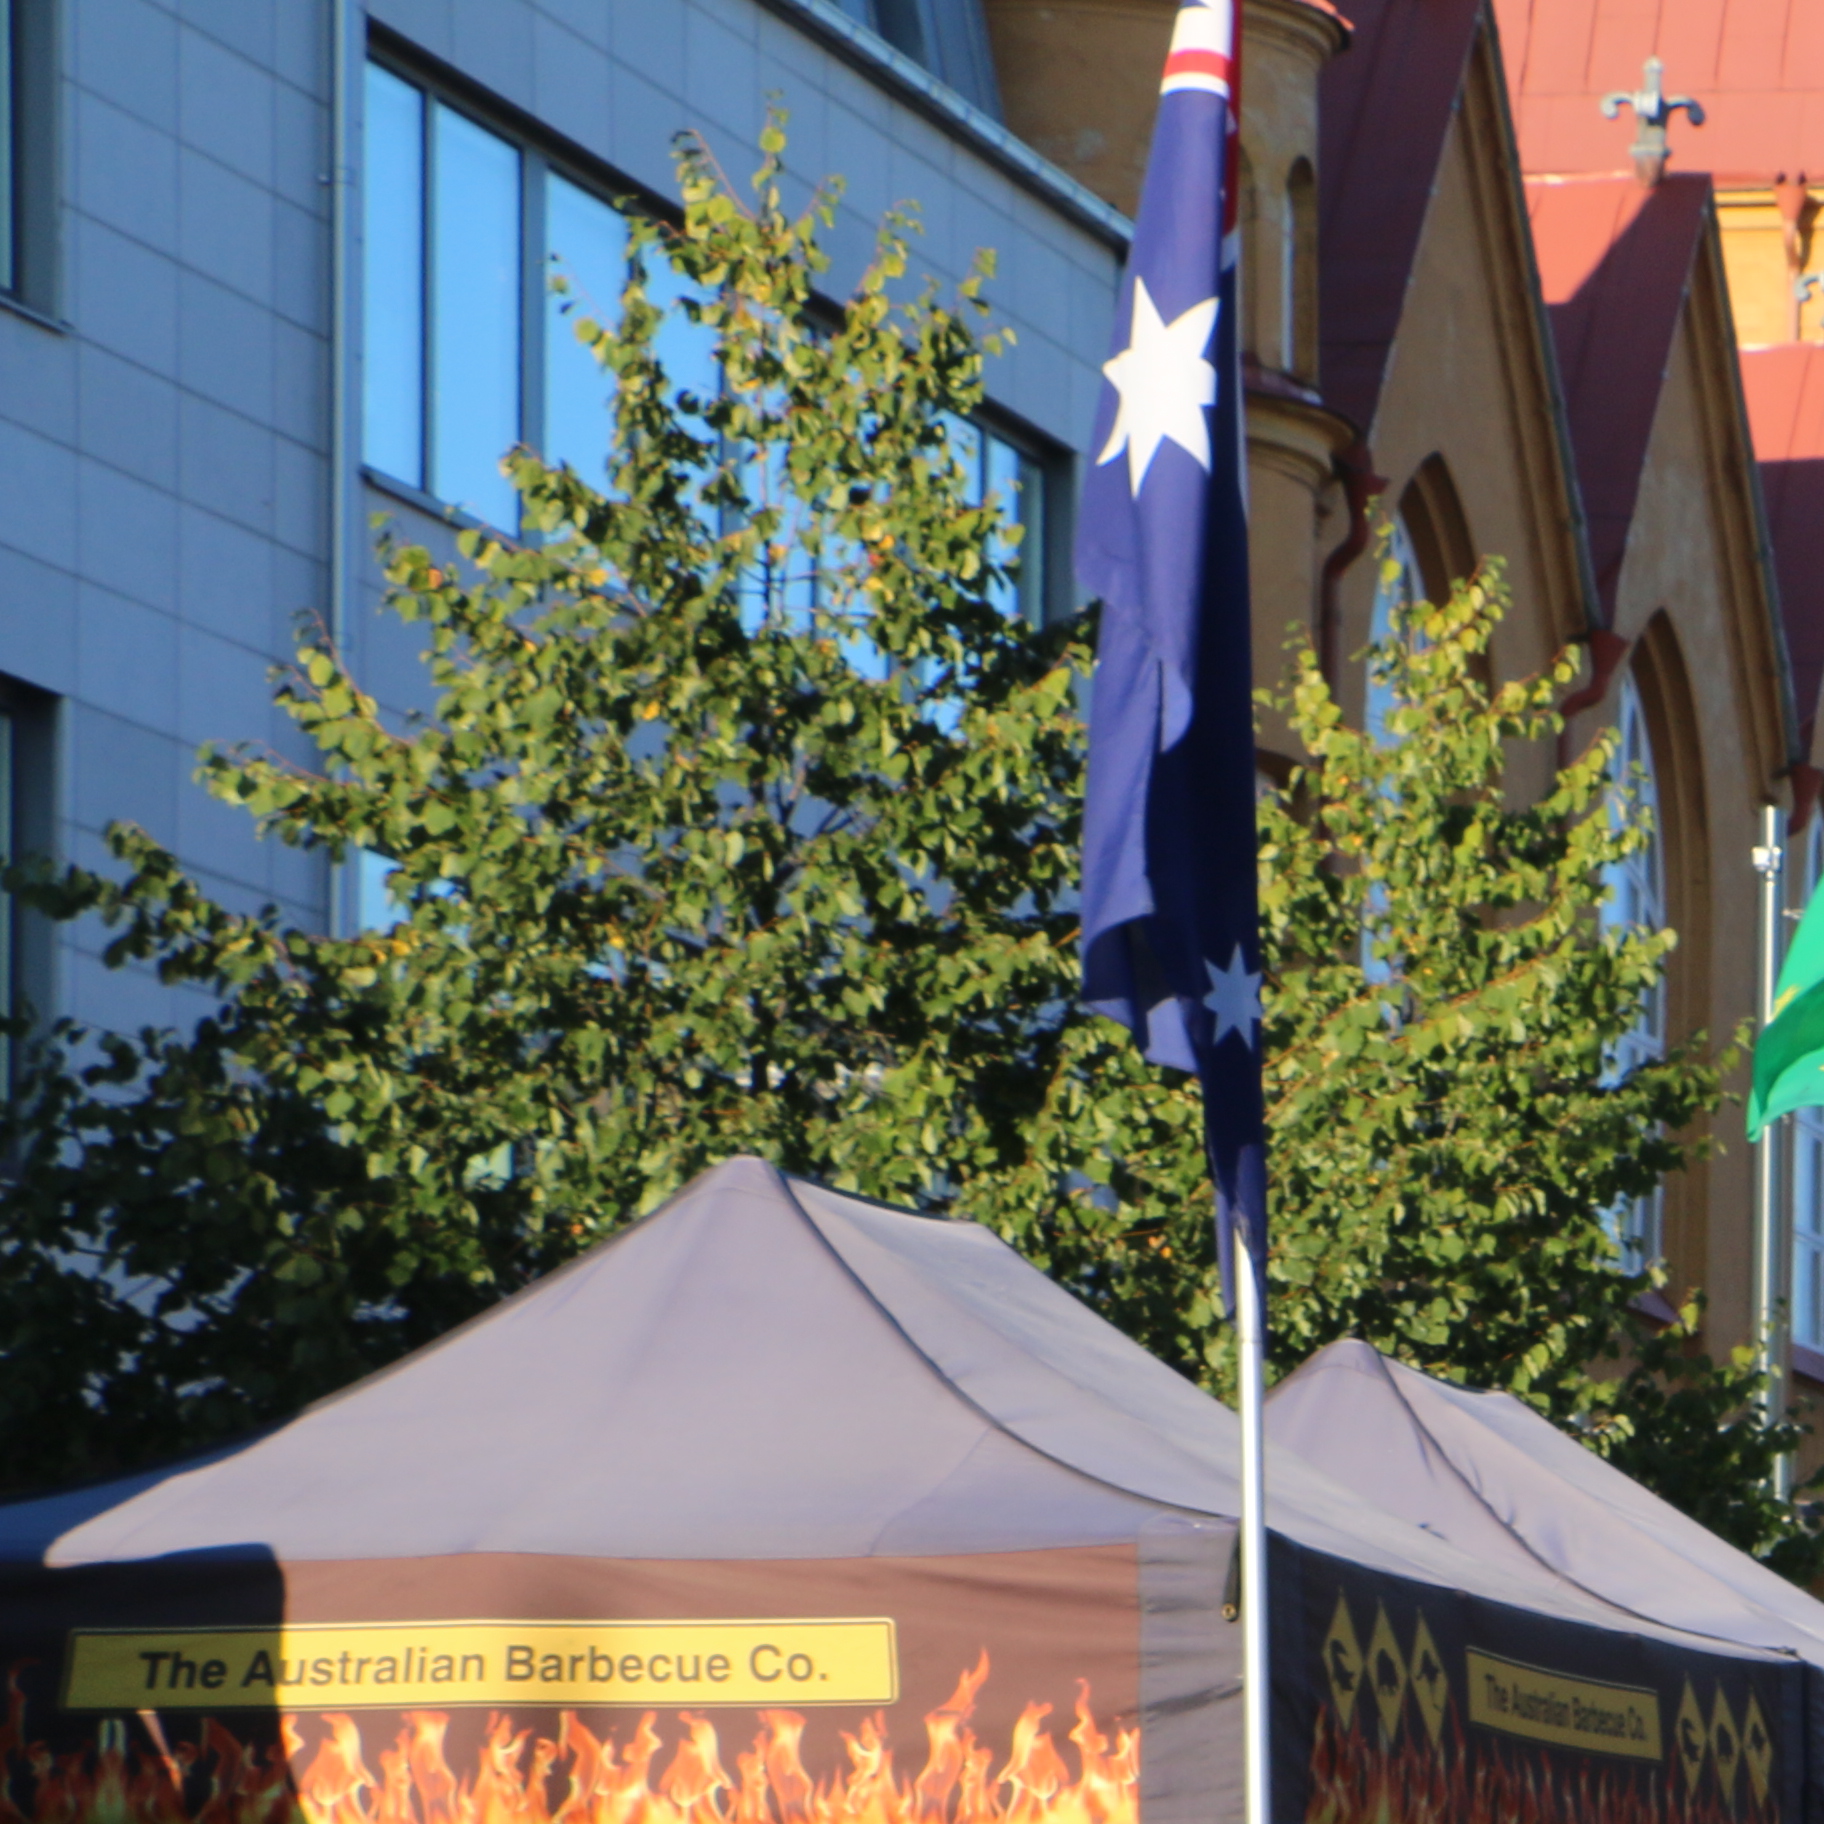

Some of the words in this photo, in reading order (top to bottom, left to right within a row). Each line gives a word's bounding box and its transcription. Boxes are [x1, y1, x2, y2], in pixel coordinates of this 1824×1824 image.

[138, 1650, 227, 1690] The
[240, 1646, 486, 1689] Australian
[505, 1643, 731, 1683] Barbecue
[748, 1643, 830, 1683] Co.
[1485, 1673, 1509, 1713] The
[1511, 1682, 1571, 1728] Australian
[1571, 1696, 1627, 1738] Barbecue
[1628, 1704, 1648, 1741] Co.
